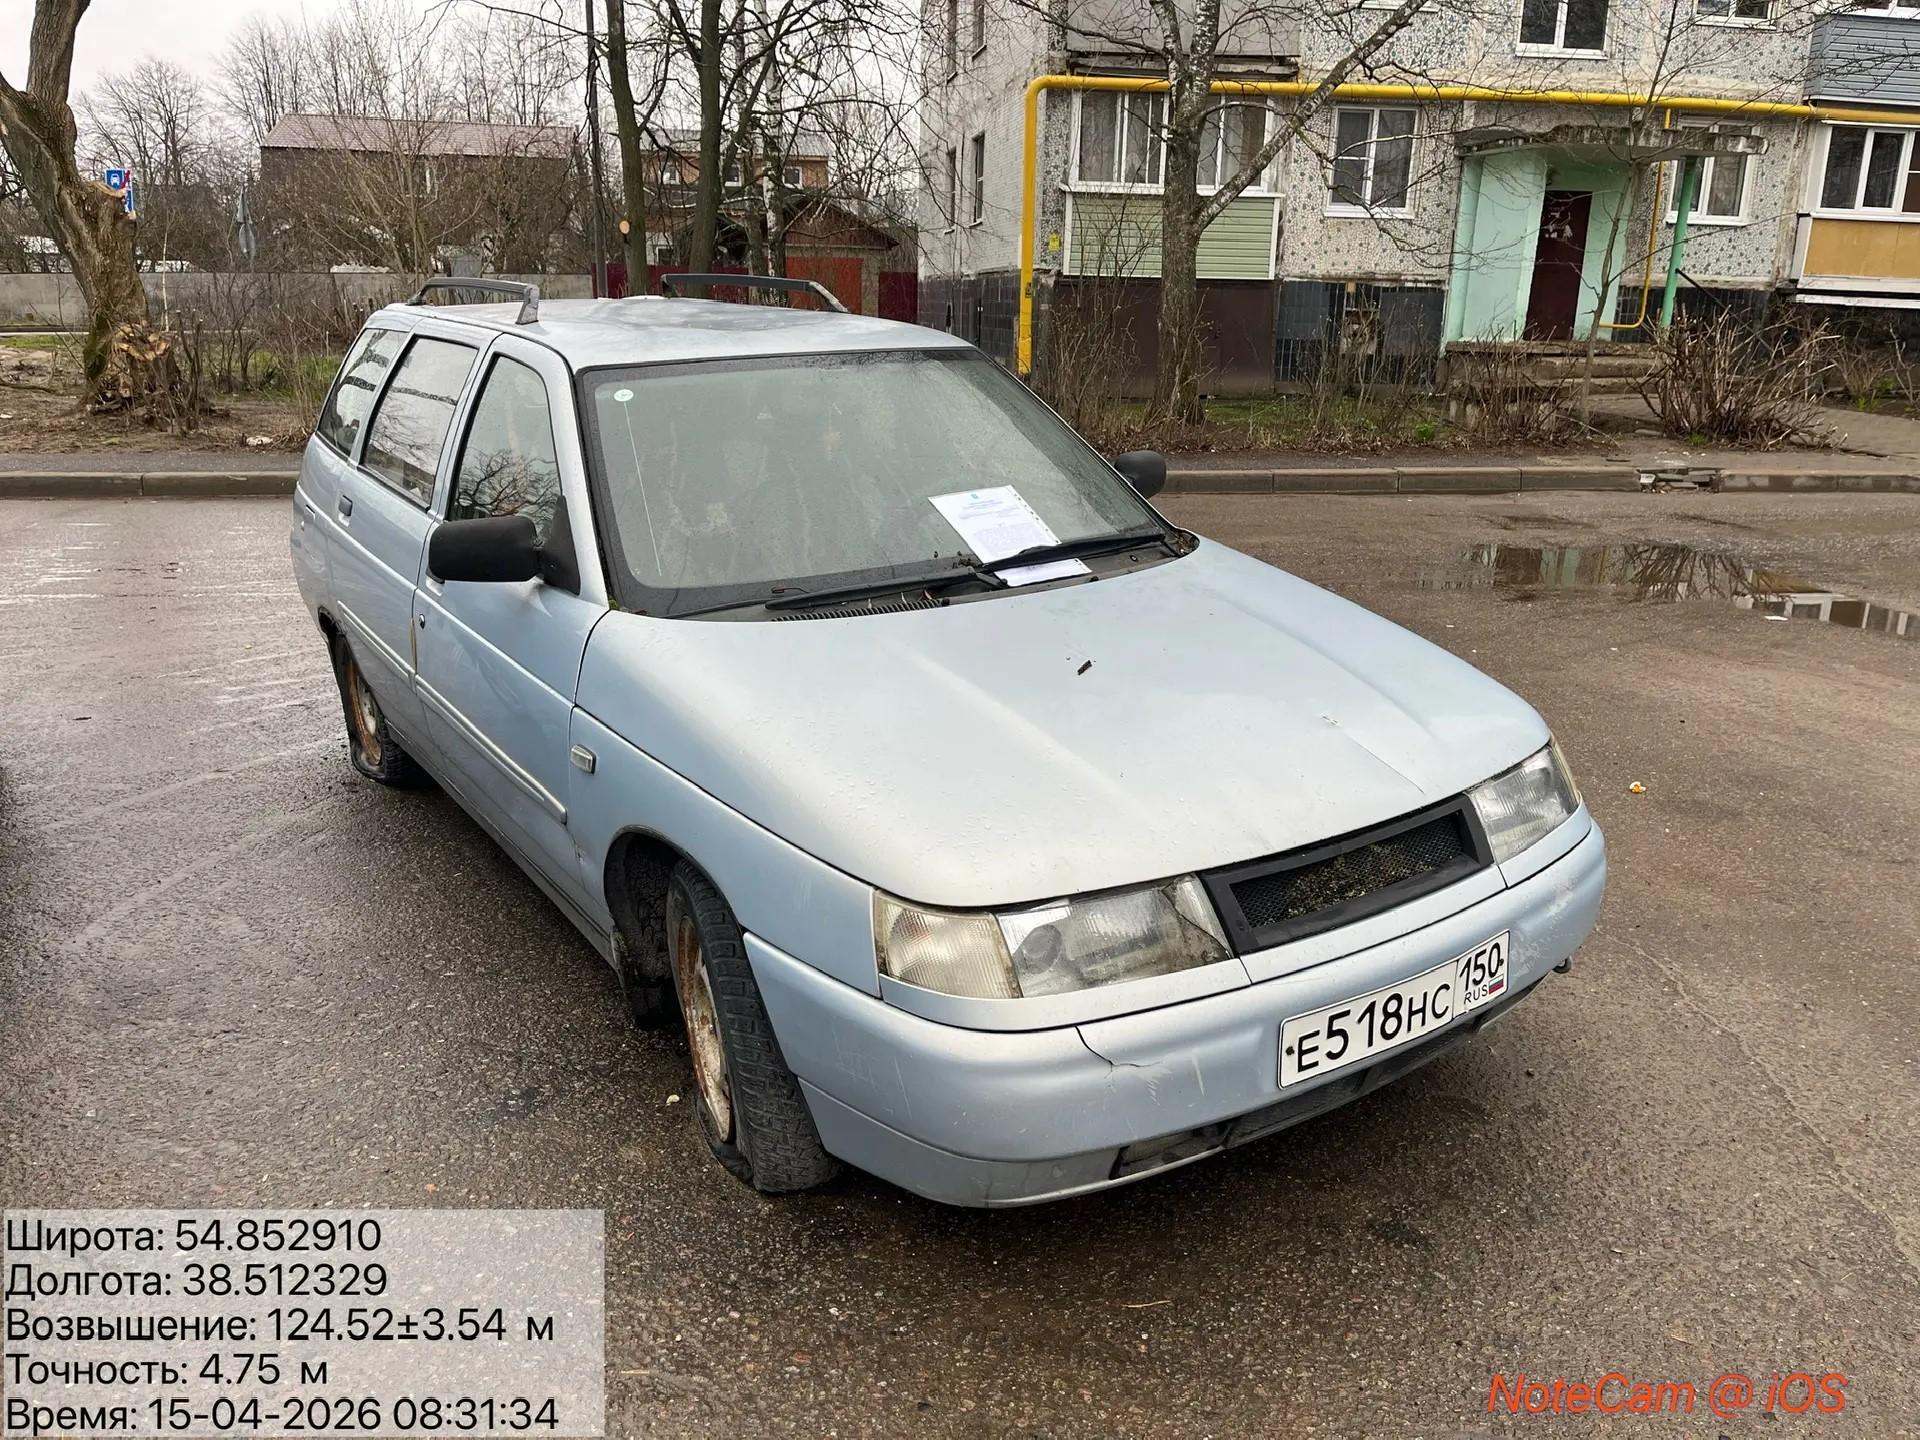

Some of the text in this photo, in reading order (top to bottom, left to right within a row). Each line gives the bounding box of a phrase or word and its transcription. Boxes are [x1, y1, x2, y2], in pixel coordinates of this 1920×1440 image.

[1297, 942, 1501, 1073] Е518НС 150
[1464, 986, 1489, 1005] RUS
